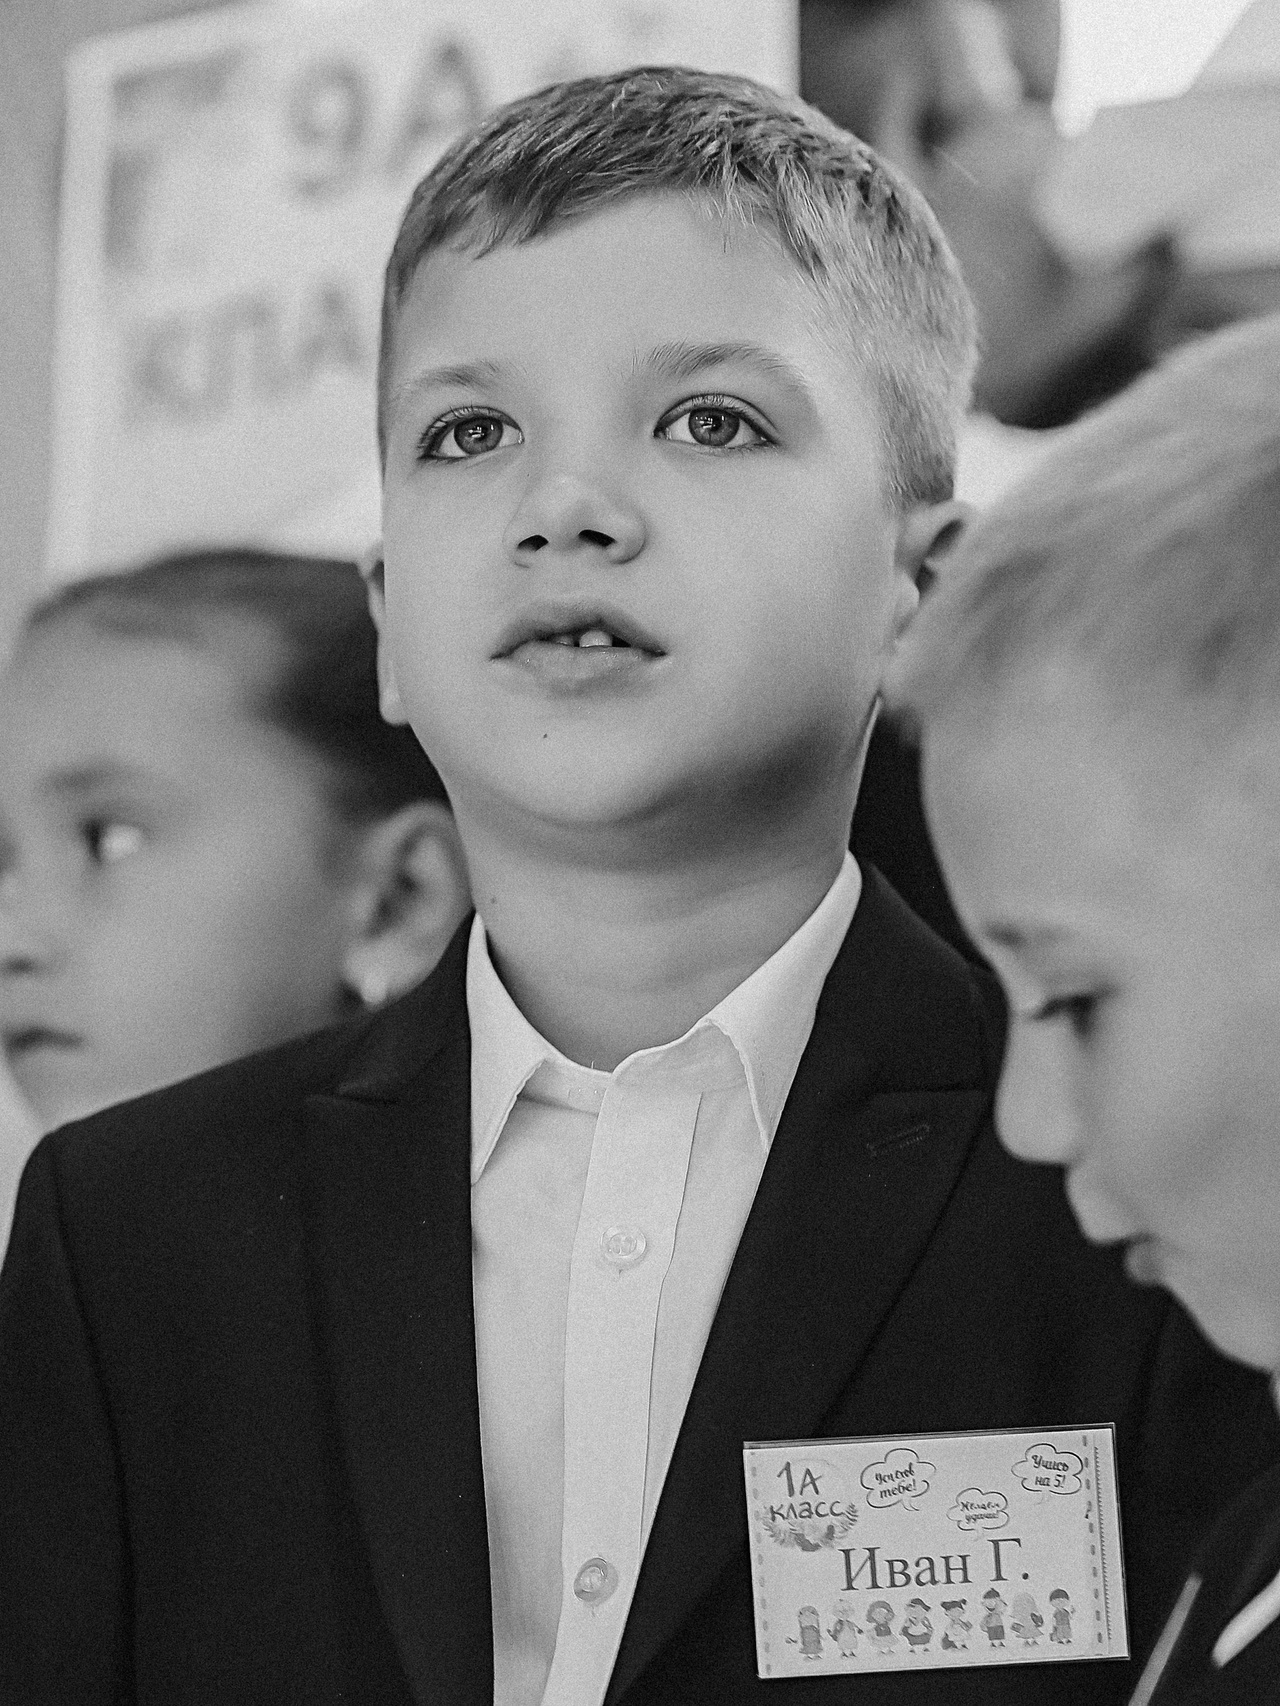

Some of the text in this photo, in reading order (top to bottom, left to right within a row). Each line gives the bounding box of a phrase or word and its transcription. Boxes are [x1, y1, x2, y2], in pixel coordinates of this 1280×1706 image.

[1031, 1454, 1070, 1472] Учись
[776, 1461, 822, 1498] 1А
[879, 1478, 917, 1500] тебе!
[1034, 1473, 1066, 1489] на 5!
[837, 1537, 1029, 1592] Иван Г.
